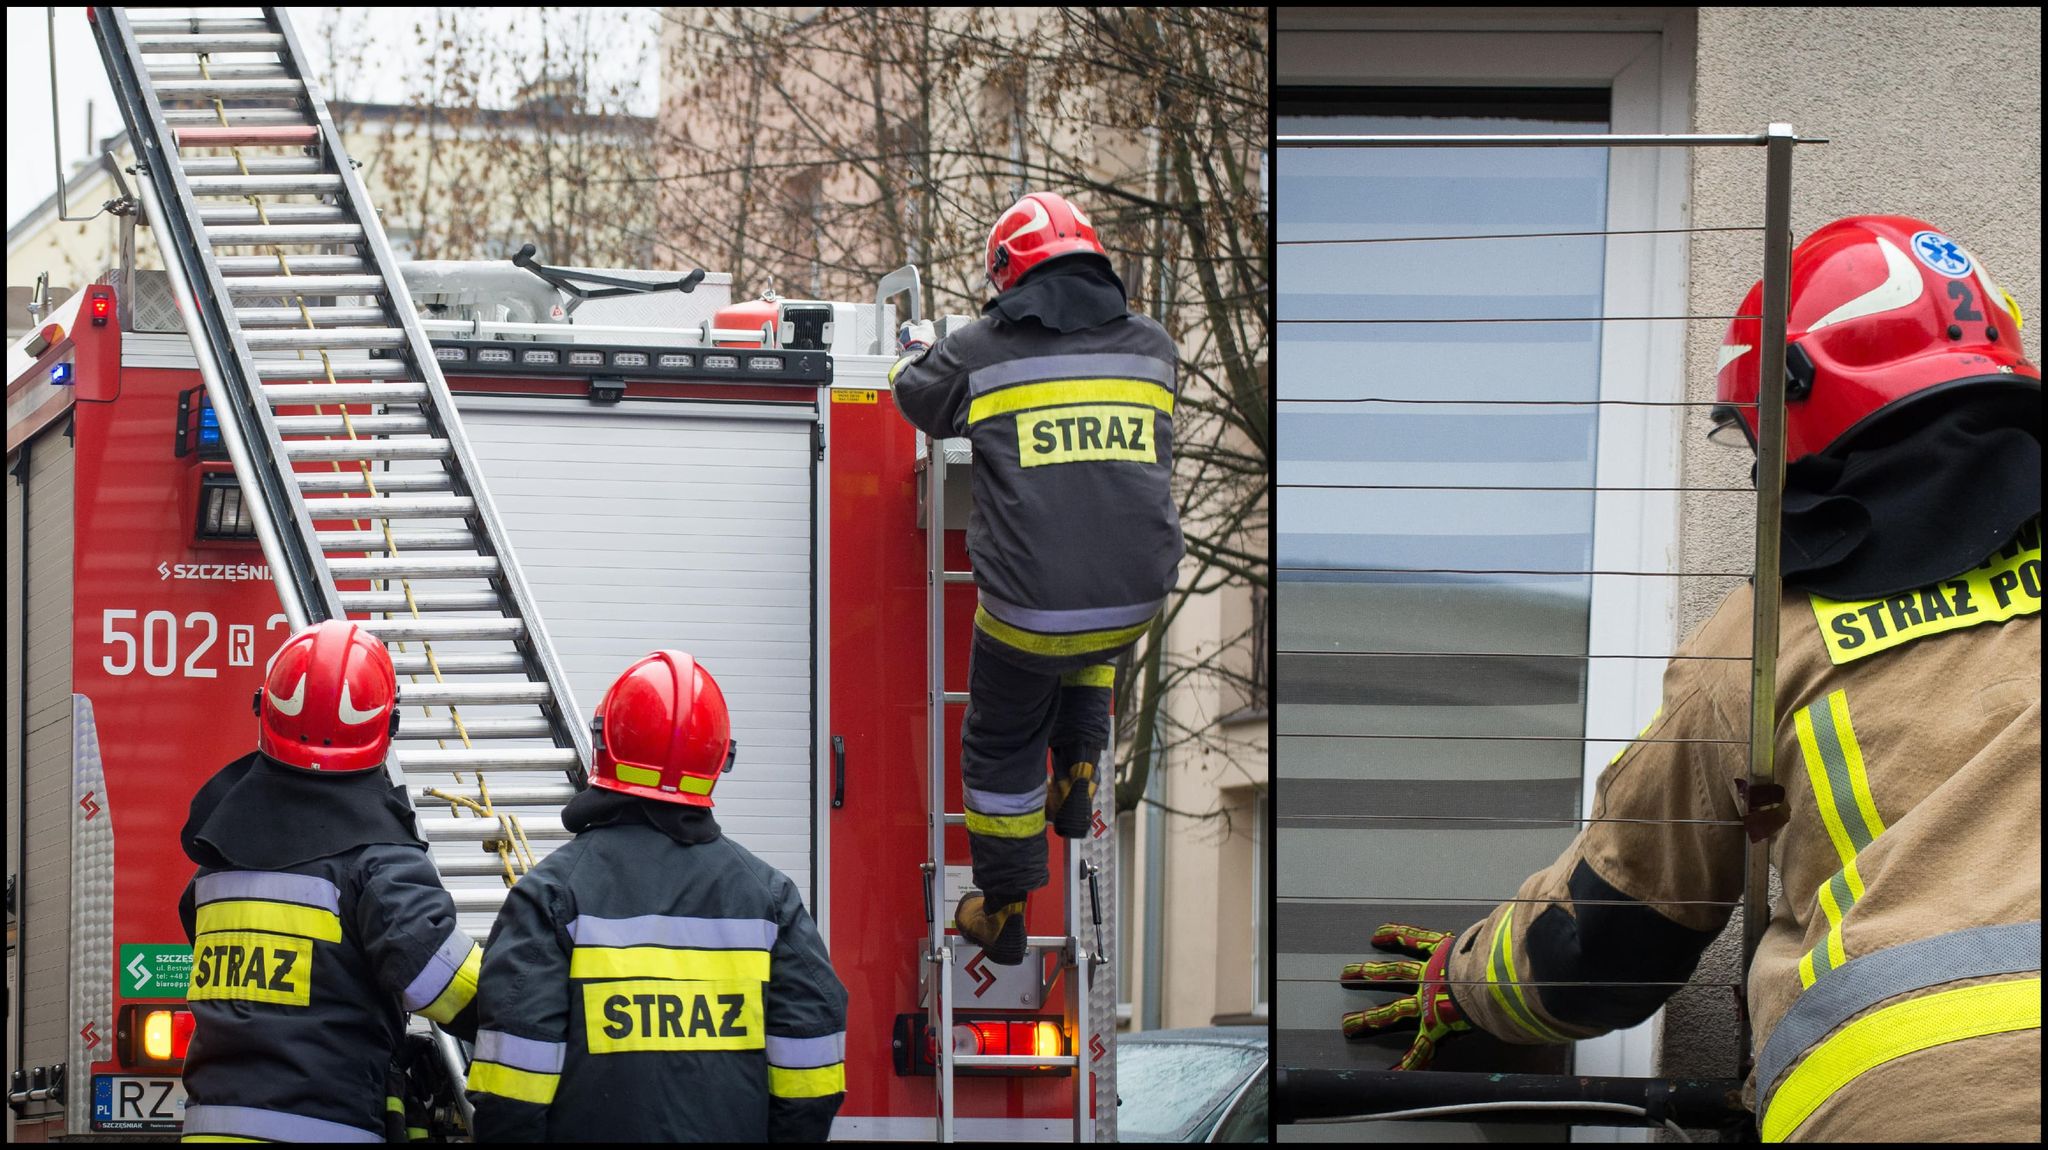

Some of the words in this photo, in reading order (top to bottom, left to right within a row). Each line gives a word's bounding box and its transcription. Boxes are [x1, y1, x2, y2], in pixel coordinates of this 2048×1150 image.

[1947, 280, 1983, 321] 2
[174, 562, 274, 582] SZCZĘŚNI
[102, 609, 218, 678] 502
[96, 1105, 111, 1115] PL
[120, 1081, 175, 1118] RZ
